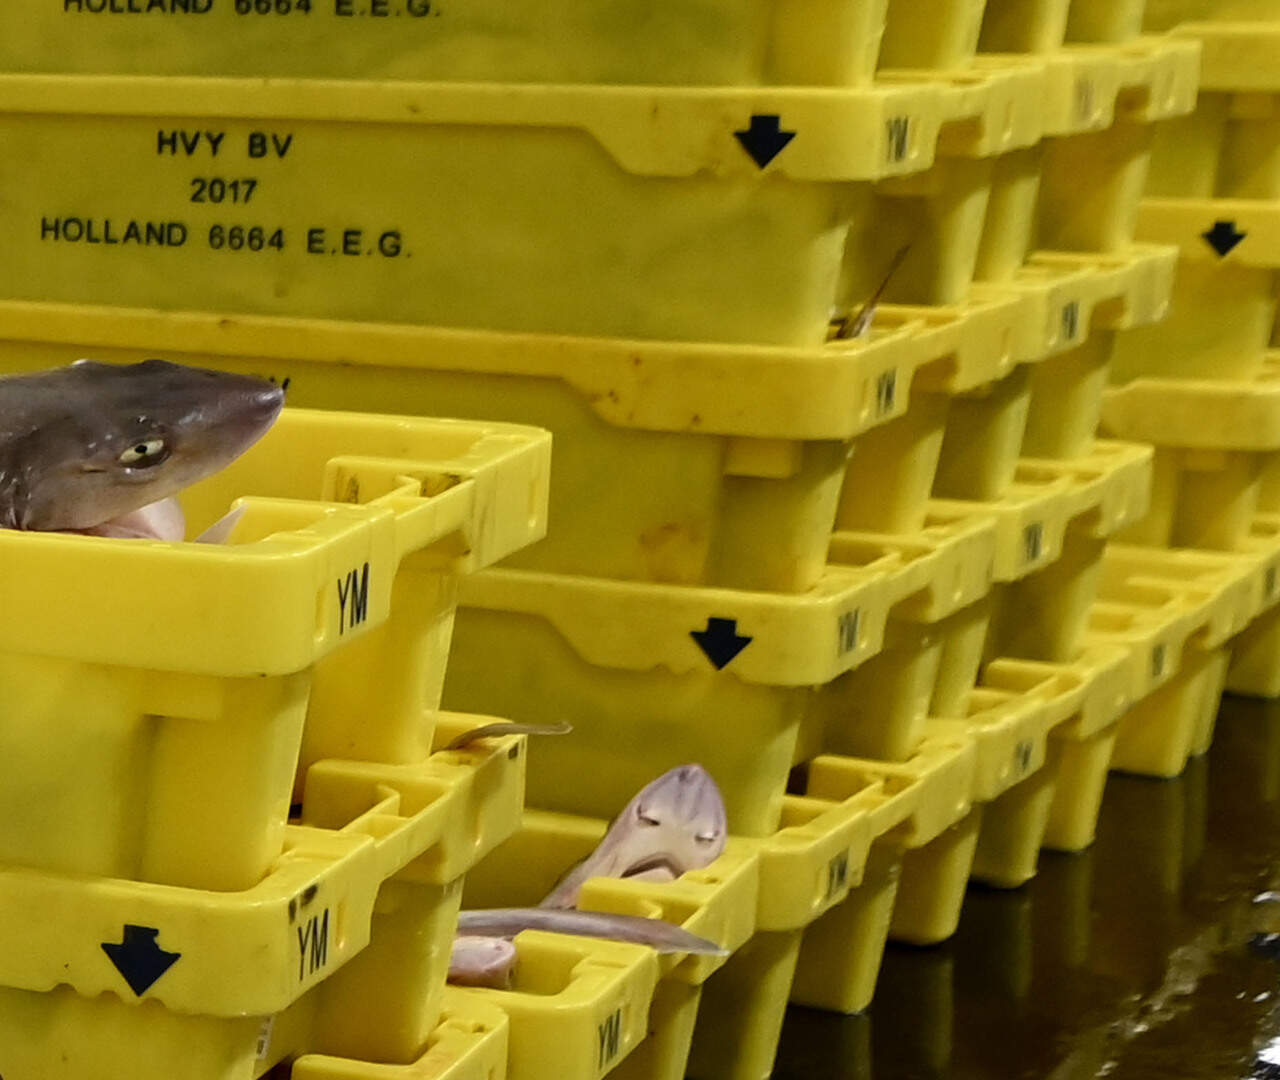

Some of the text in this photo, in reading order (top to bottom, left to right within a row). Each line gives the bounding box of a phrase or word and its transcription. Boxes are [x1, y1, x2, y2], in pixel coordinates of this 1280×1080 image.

[157, 130, 293, 159] HVY BV
[190, 177, 258, 204] 2017
[40, 216, 412, 258] HOLLAND 6664 E.E.G.
[337, 562, 369, 635] YM
[298, 908, 329, 981] YM
[599, 1007, 621, 1071] YM
